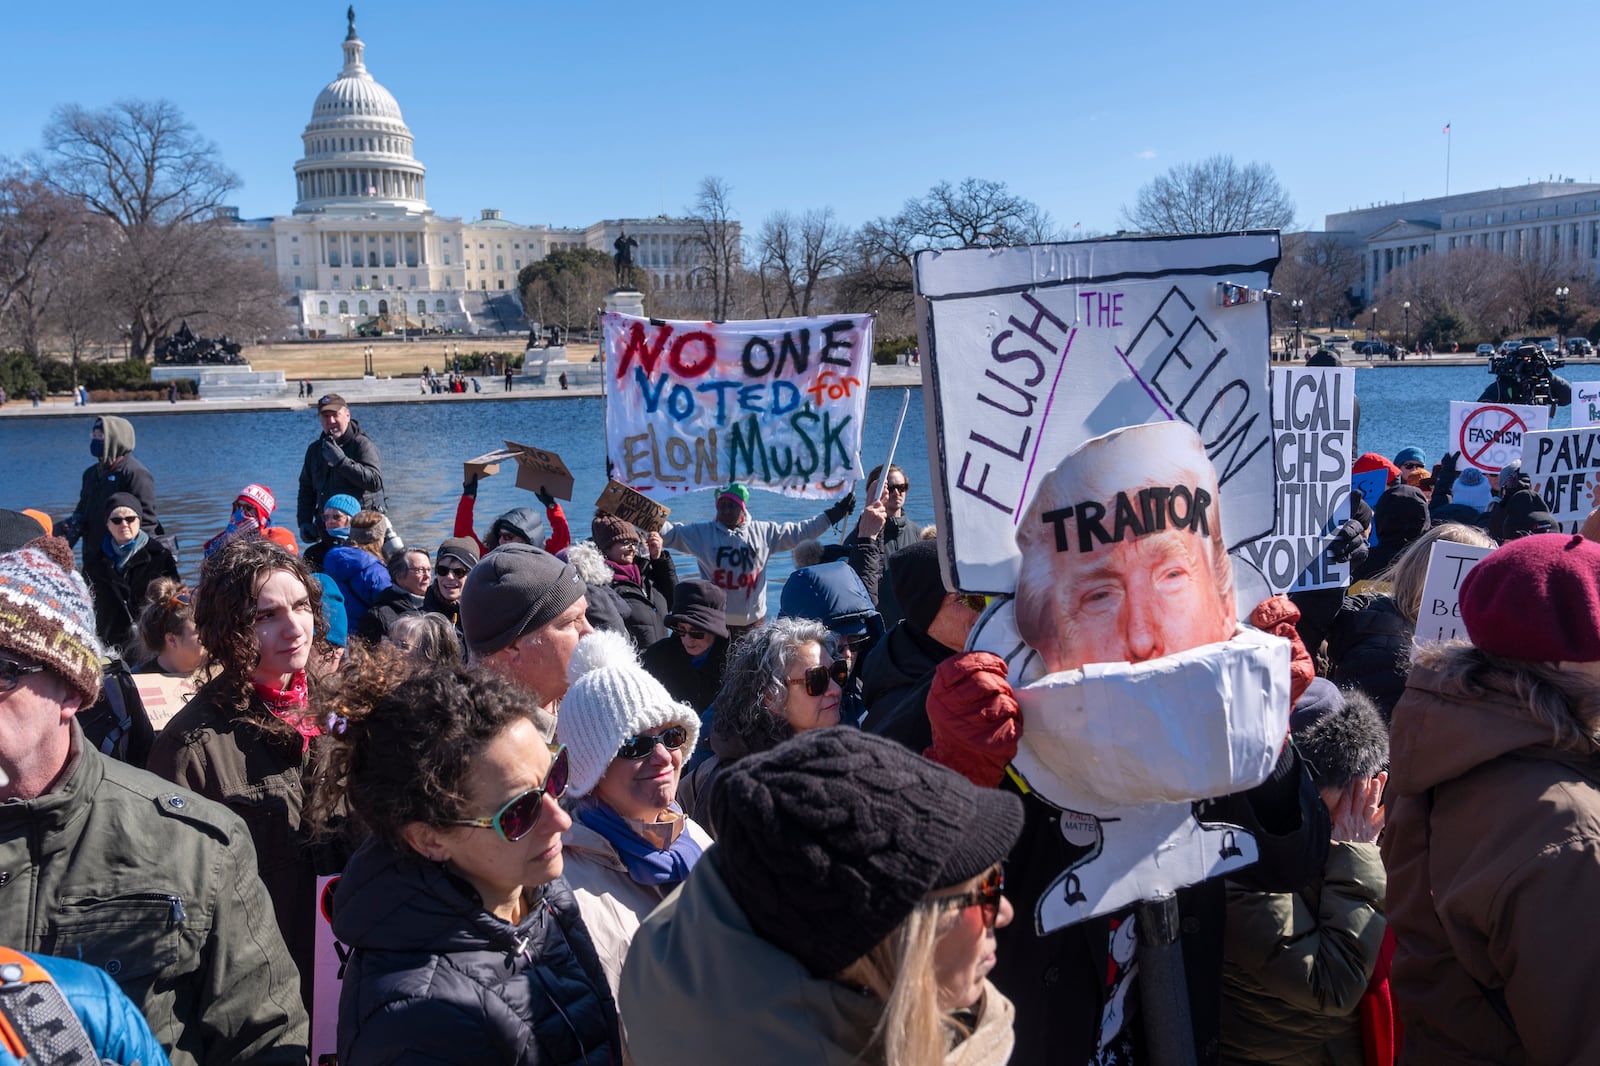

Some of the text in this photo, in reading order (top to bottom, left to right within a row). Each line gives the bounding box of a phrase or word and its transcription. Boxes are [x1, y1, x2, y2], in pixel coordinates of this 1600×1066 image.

[1079, 291, 1125, 328] THE
[617, 320, 855, 379] NO ONE
[634, 366, 861, 426] VOTED for
[955, 290, 1069, 515] FLUSH
[1124, 284, 1270, 494] FELON
[624, 423, 719, 484] ELON
[1275, 432, 1346, 483] CHS
[1468, 427, 1522, 447] FASCISM
[1041, 484, 1213, 553] TRAITOR
[1543, 473, 1586, 515] OFF
